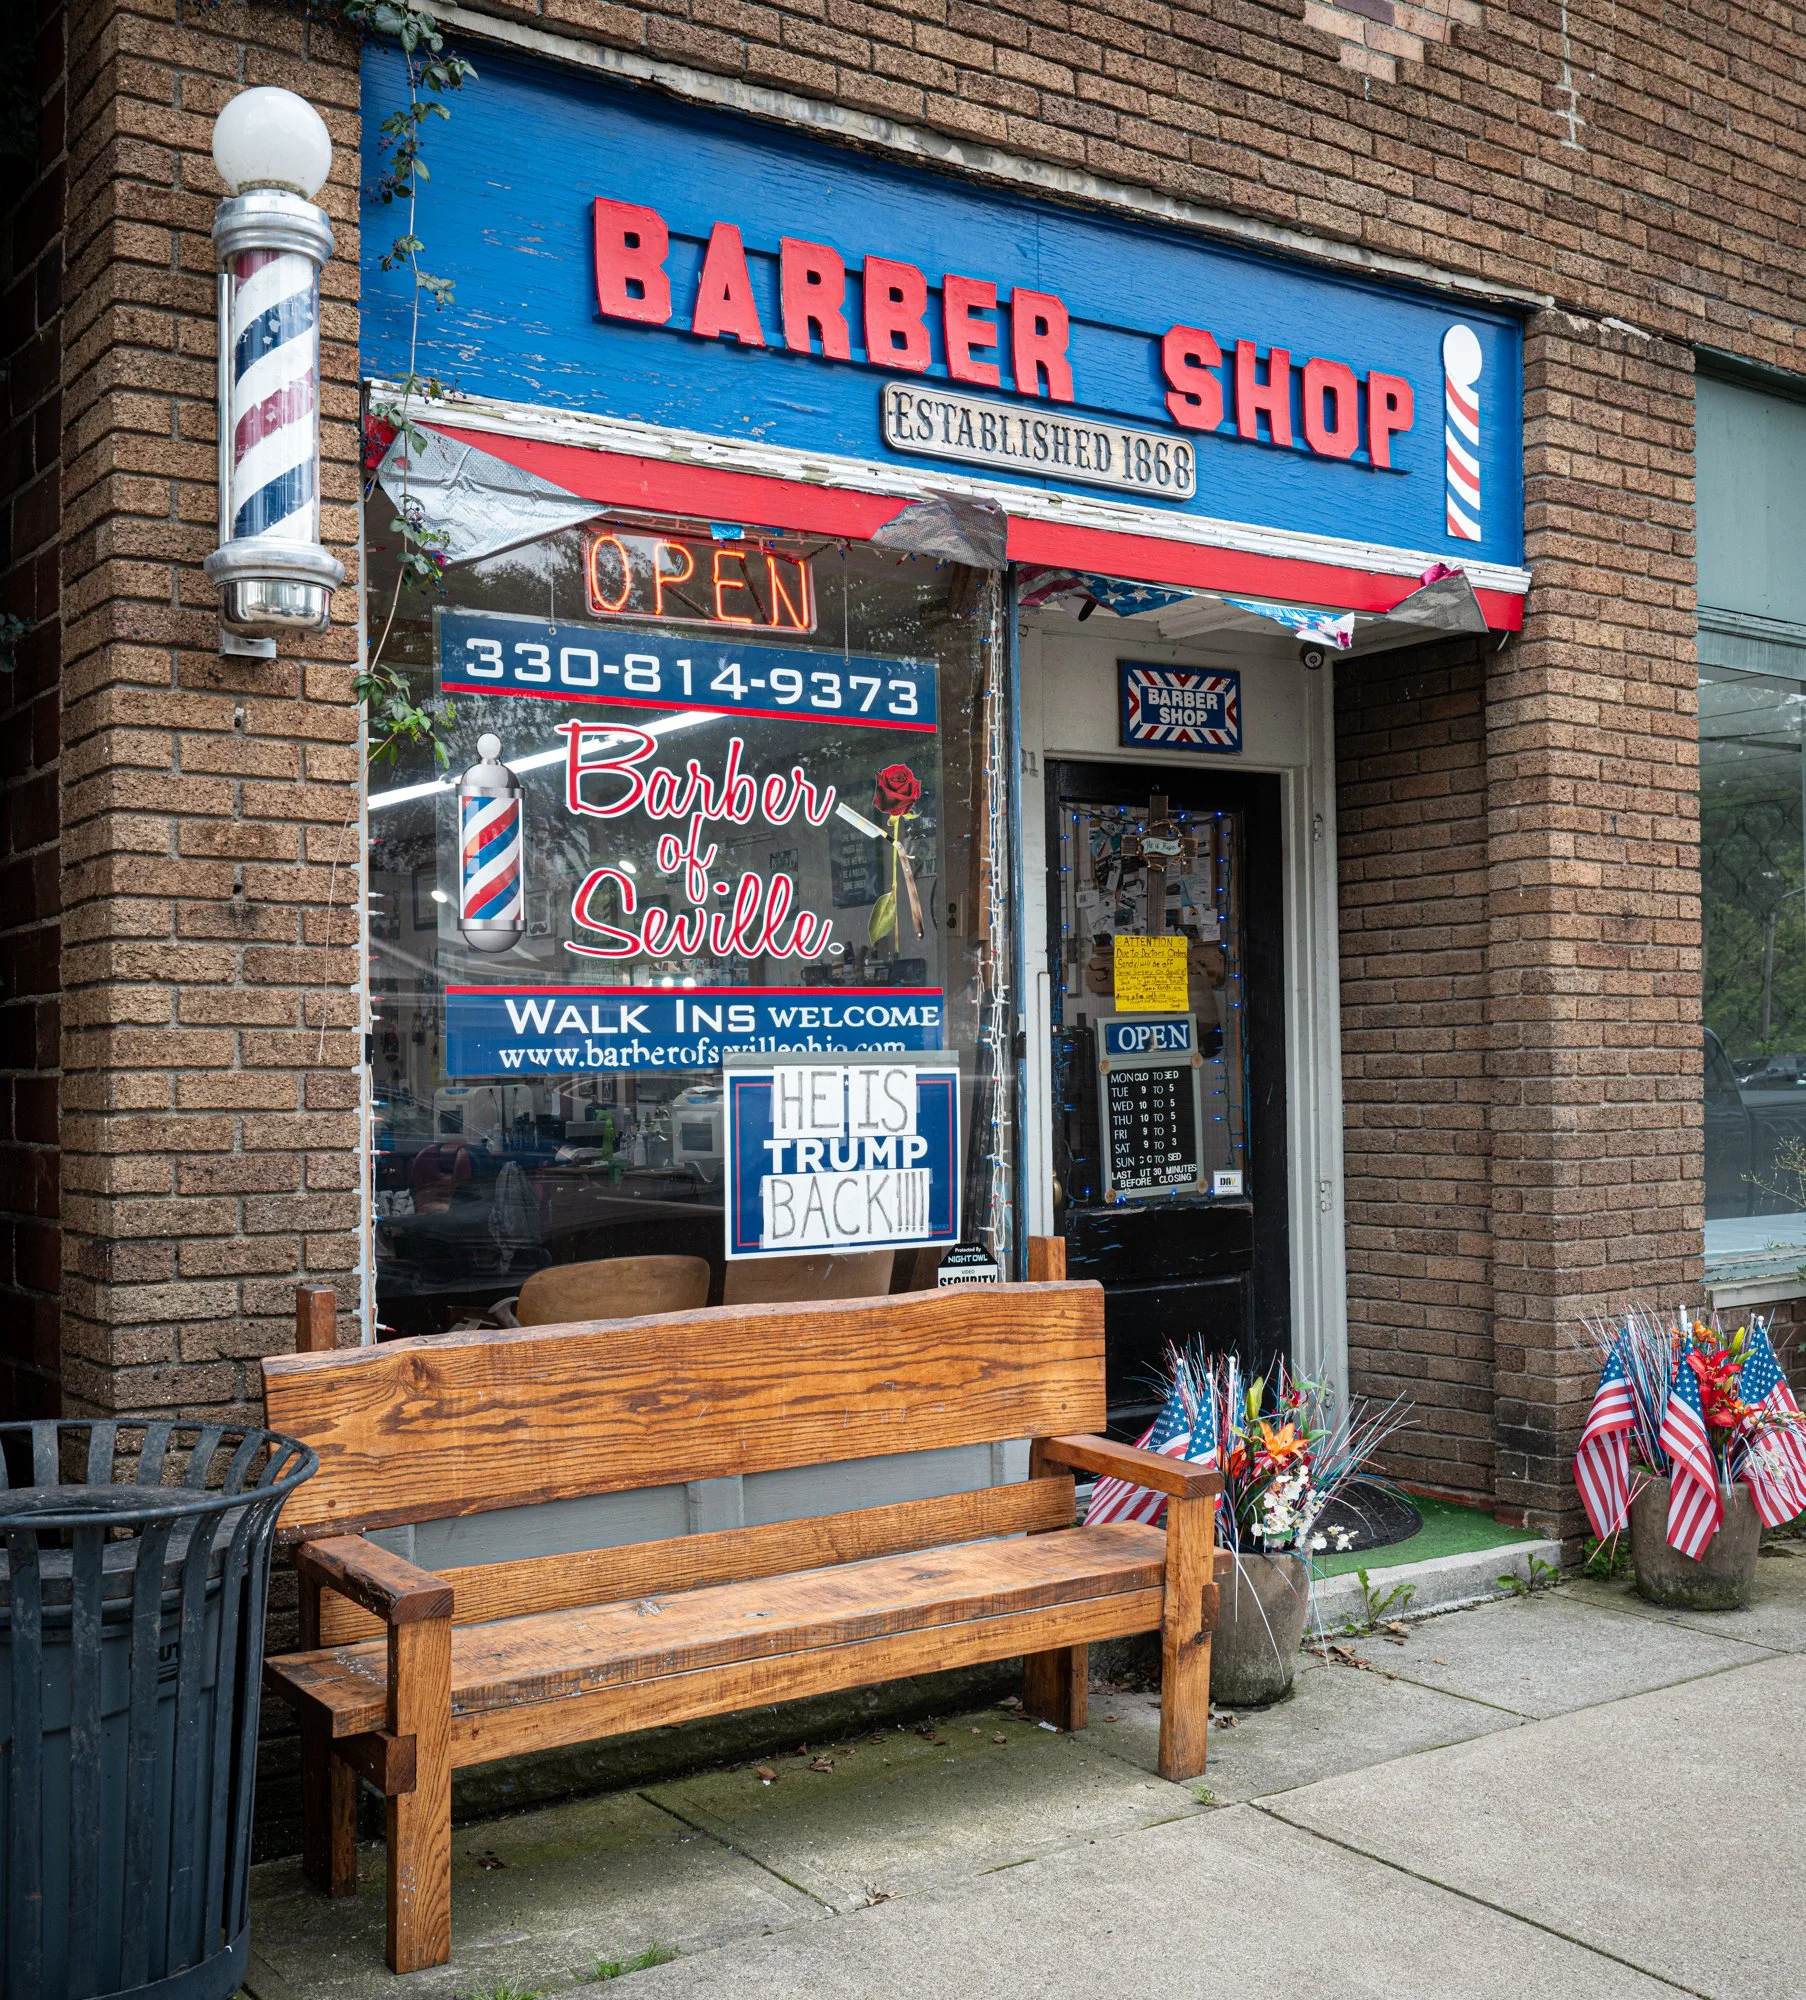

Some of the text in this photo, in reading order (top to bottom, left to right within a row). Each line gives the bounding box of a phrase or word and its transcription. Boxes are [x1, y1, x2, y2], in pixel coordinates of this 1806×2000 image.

[594, 196, 1414, 468] BARBER SHOP
[894, 387, 1194, 489] ESTABLISHED 1868
[588, 534, 811, 632] OPEN
[465, 636, 919, 717] 330-814-9373
[1147, 688, 1218, 710] BARBER
[1159, 706, 1208, 726] SHOP
[555, 718, 836, 828] Barber
[657, 810, 718, 904] of
[1123, 936, 1173, 947] ATTENTION
[1116, 948, 1129, 958] Due
[1141, 947, 1164, 958] Doctors
[506, 998, 941, 1036] WALK INS WELCOME
[1117, 1023, 1189, 1051] OPEN
[1110, 1072, 1134, 1084] MON
[1134, 1072, 1149, 1081] CLO
[1152, 1071, 1164, 1081] TO
[1111, 1083, 1175, 1097] TUE 9 TO 5
[780, 1069, 909, 1132] HE IS
[1111, 1098, 1176, 1112] WED 10 TO 5
[1112, 1111, 1176, 1126] THU 10 TO 5
[1113, 1124, 1177, 1140] FRI 9 TO 3
[763, 1135, 929, 1175] TRUMP
[1115, 1137, 1177, 1155] SAT 9 TO 3
[1115, 1156, 1135, 1168] SUN
[1154, 1154, 1165, 1164] TO
[1167, 1152, 1182, 1161] SED
[1111, 1163, 1198, 1181] LAST UT 30 MINUTES
[1120, 1172, 1192, 1188] BEFORE CLOSING
[1220, 1176, 1236, 1186] DAV
[770, 1171, 925, 1241] BACK!!!!
[975, 1245, 982, 1253] By
[947, 1253, 988, 1264] NIGHT OWL
